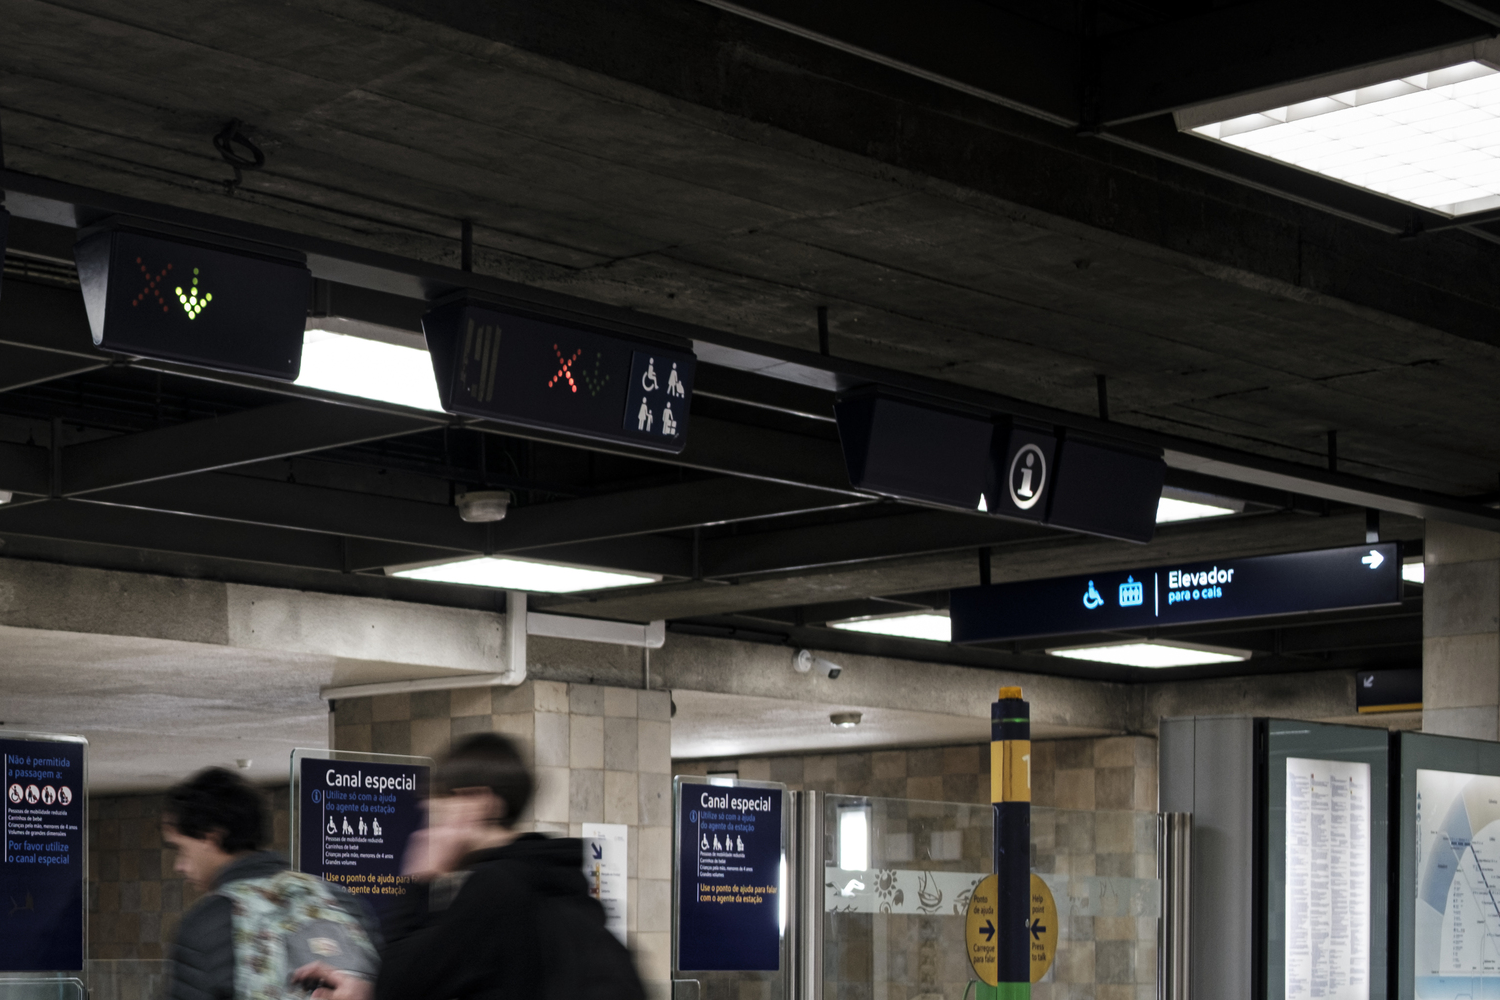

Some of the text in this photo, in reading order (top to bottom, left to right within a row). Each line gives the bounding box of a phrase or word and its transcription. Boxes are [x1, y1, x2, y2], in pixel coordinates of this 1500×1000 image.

[1169, 566, 1234, 589] Elevador
[1168, 585, 1222, 605] para o cais
[8, 755, 70, 767] Não é permitida
[15, 769, 54, 780] passagem
[326, 769, 416, 793] Canal especial
[326, 790, 347, 800] Utilize
[349, 792, 357, 800] só
[379, 793, 396, 804] ajuda
[326, 802, 395, 814] do agente da estação
[701, 792, 771, 814] Canal especial
[9, 840, 69, 851] Por favor utilize
[16, 854, 36, 863] canal
[38, 855, 69, 866] especial
[700, 883, 710, 891] Use
[716, 885, 731, 893] ponto
[732, 884, 739, 892] de
[740, 885, 753, 894] ajuda
[717, 895, 734, 904] agente
[736, 894, 742, 902] da
[743, 895, 762, 904] estação
[974, 895, 988, 903] Ponto
[1032, 895, 1043, 904] Help
[974, 906, 993, 916] de ajuda
[1032, 906, 1044, 914] point
[973, 944, 995, 954] Carregue
[973, 954, 995, 964] para falar
